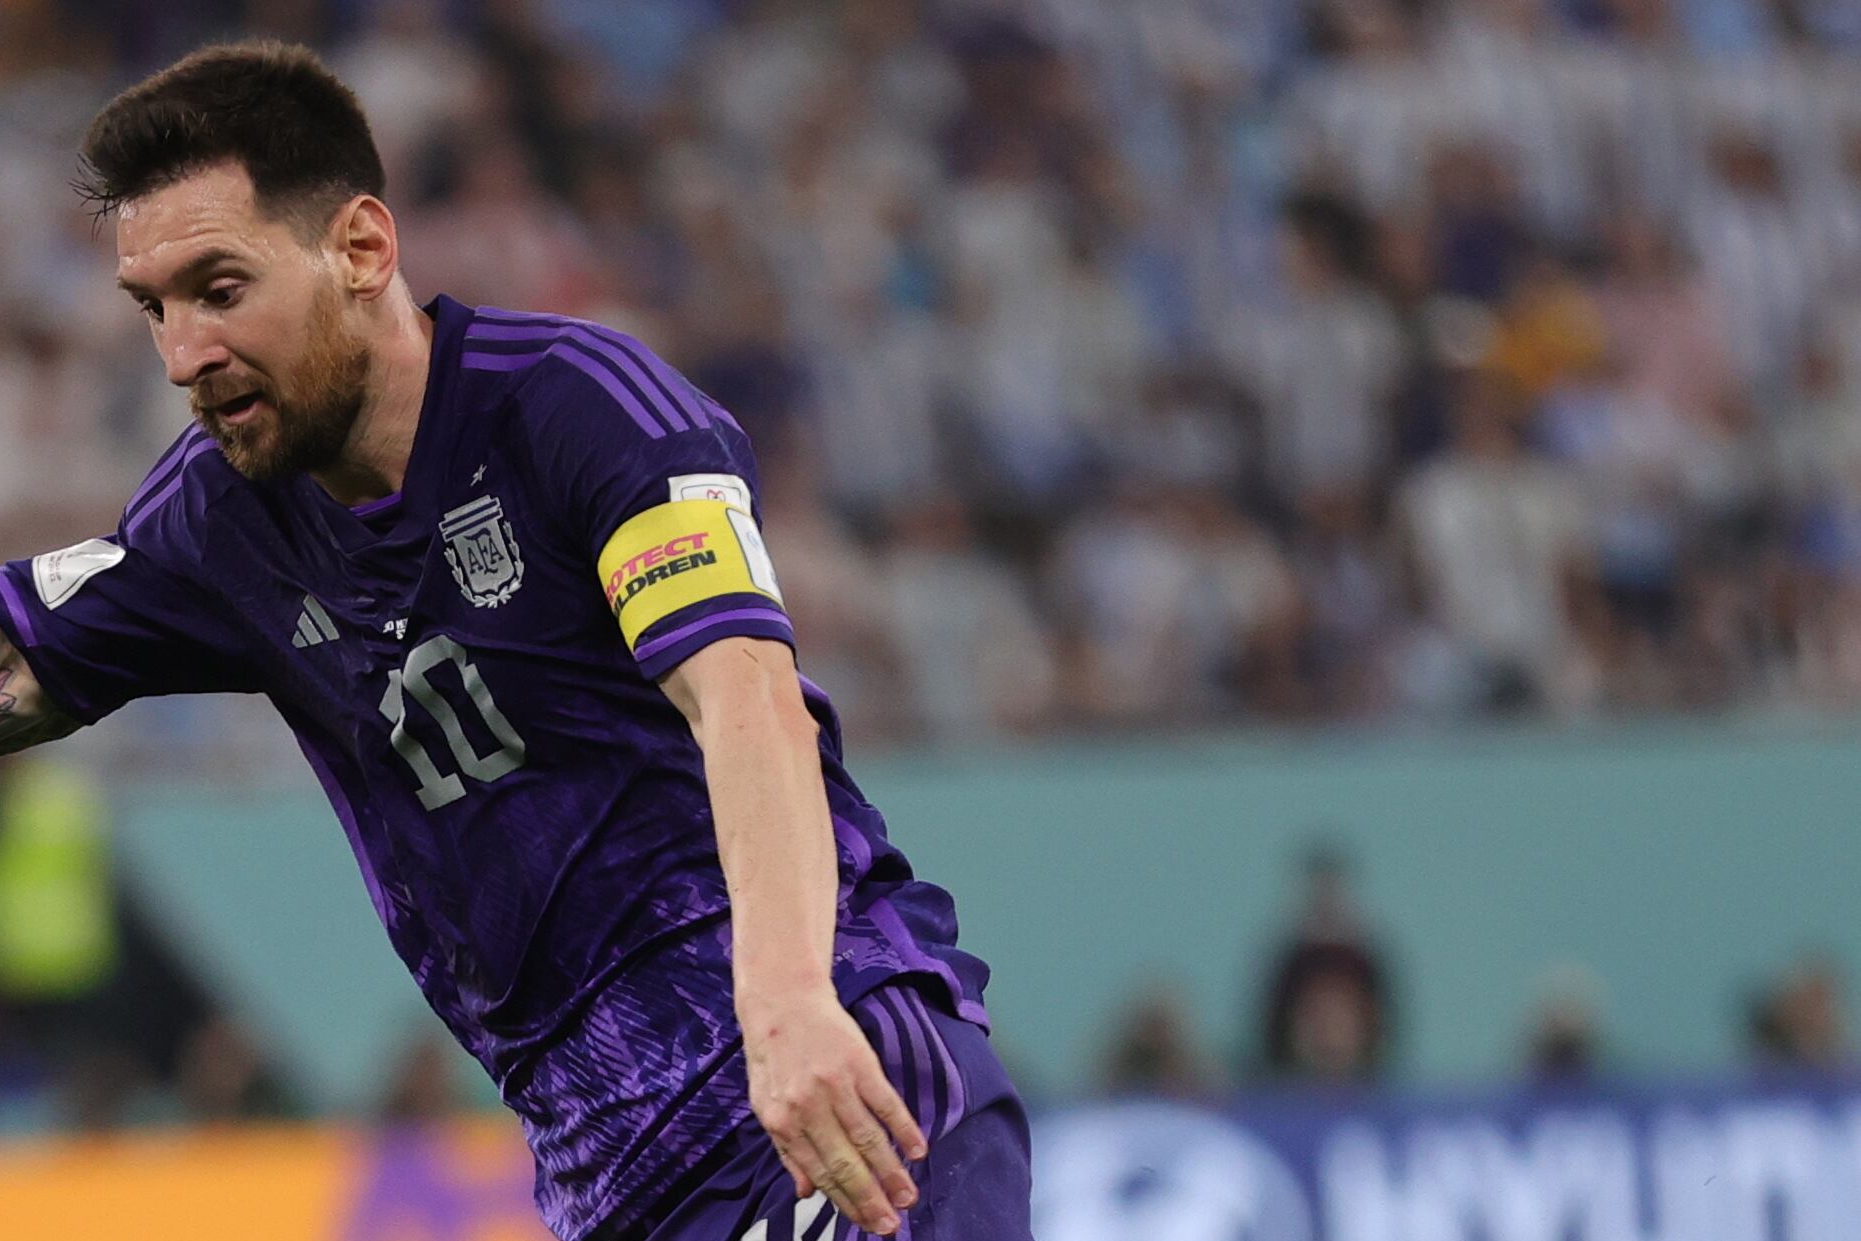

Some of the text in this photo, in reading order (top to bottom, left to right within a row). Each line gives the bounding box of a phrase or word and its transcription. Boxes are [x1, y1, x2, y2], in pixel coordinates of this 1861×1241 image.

[453, 527, 505, 575] AFA
[606, 532, 710, 602] OTECT
[378, 634, 526, 812] 10
